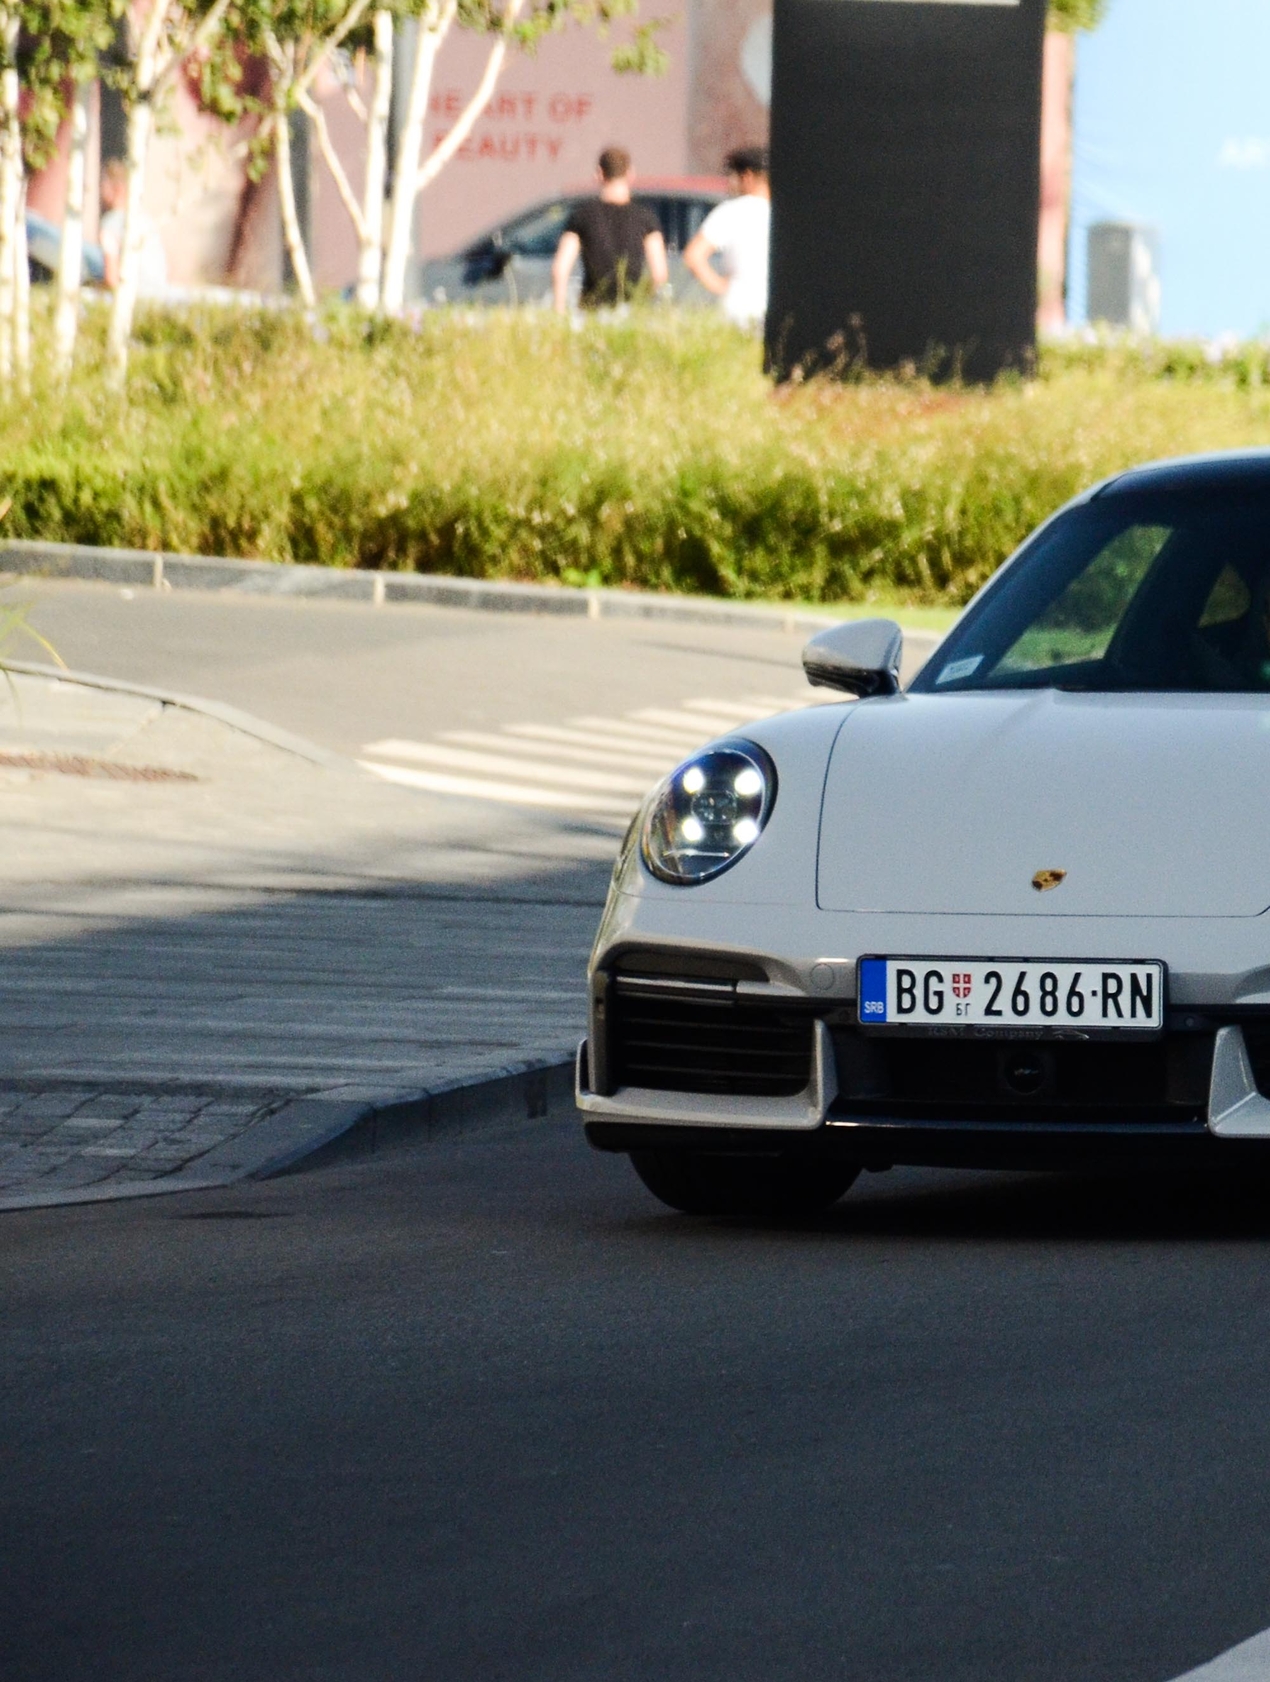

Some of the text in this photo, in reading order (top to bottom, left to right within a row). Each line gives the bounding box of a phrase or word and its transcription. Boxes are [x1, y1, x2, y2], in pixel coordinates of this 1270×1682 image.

[549, 92, 592, 123] OF
[896, 969, 944, 1015] BG
[864, 1001, 884, 1014] SRB
[973, 1028, 1044, 1040] Company
